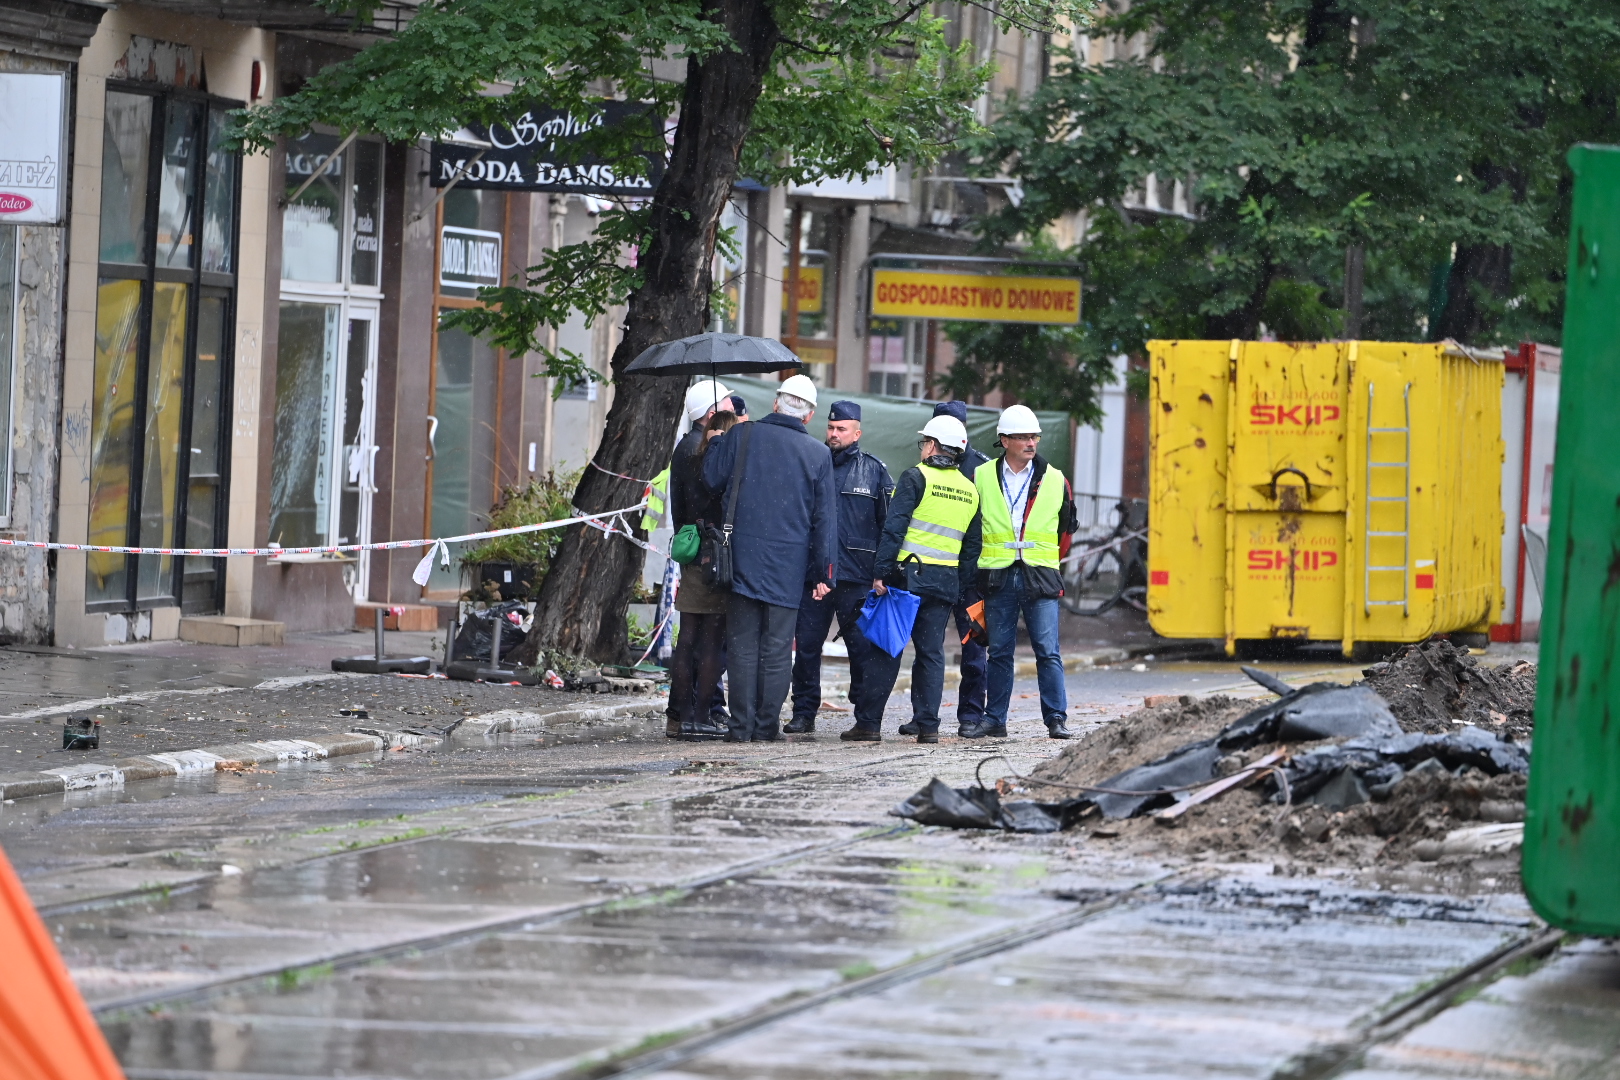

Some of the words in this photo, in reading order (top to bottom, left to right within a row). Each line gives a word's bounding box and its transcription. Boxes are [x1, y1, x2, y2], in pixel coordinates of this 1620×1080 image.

[440, 159, 525, 183] MODA
[0, 197, 27, 210] odeo
[442, 237, 465, 274] MODA
[466, 240, 498, 278] DAMSKA
[877, 282, 1004, 309] GOSPODARSTWO
[1008, 288, 1076, 312] DOMOWE
[316, 306, 336, 501] WYPRZEDAŻ
[1249, 404, 1341, 426] SKIP
[1247, 549, 1339, 571] SKIP
